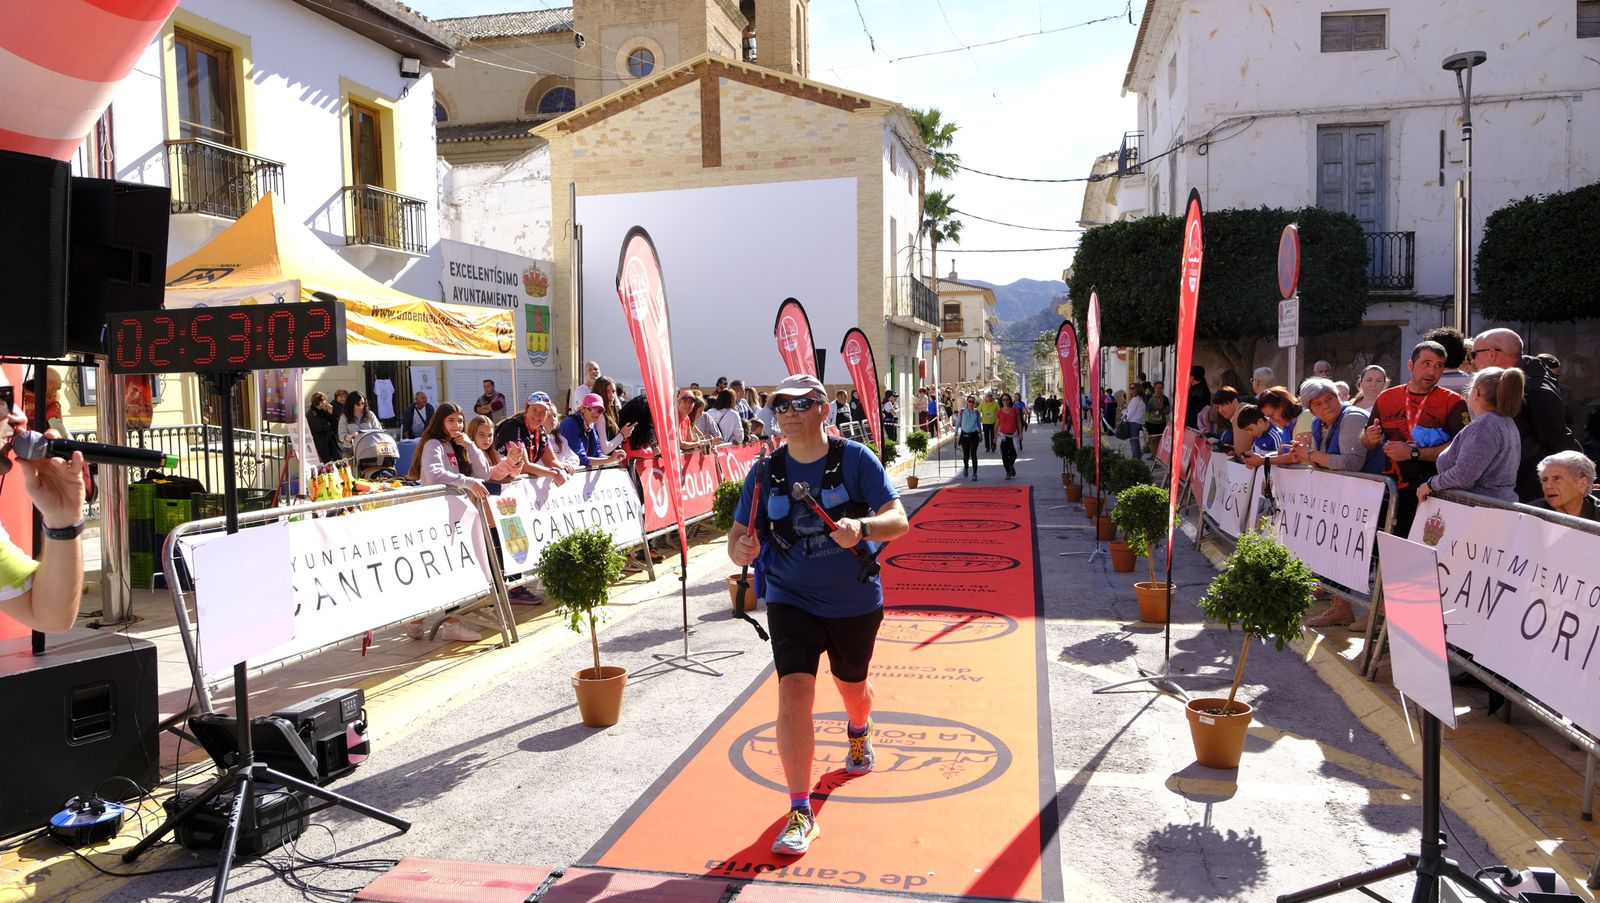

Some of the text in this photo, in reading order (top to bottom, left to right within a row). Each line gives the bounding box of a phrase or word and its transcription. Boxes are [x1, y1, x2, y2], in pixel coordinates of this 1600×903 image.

[449, 261, 519, 287] EXCELENTÍSIMO
[452, 286, 519, 308] AYUNTAMIENTO
[116, 308, 331, 368] 02:53:02
[681, 470, 714, 501] EOLIA
[530, 488, 612, 513] AYUNTAMENTO
[532, 500, 636, 543] CANTORIA
[1355, 508, 1368, 524] DE
[290, 520, 463, 573] YUNTAMIENTO DE
[1437, 562, 1600, 670] CANTORI
[867, 671, 984, 682] Ayuntami
[872, 664, 937, 672] Canto
[938, 731, 977, 743] LA
[705, 858, 928, 890] de Cantoria
